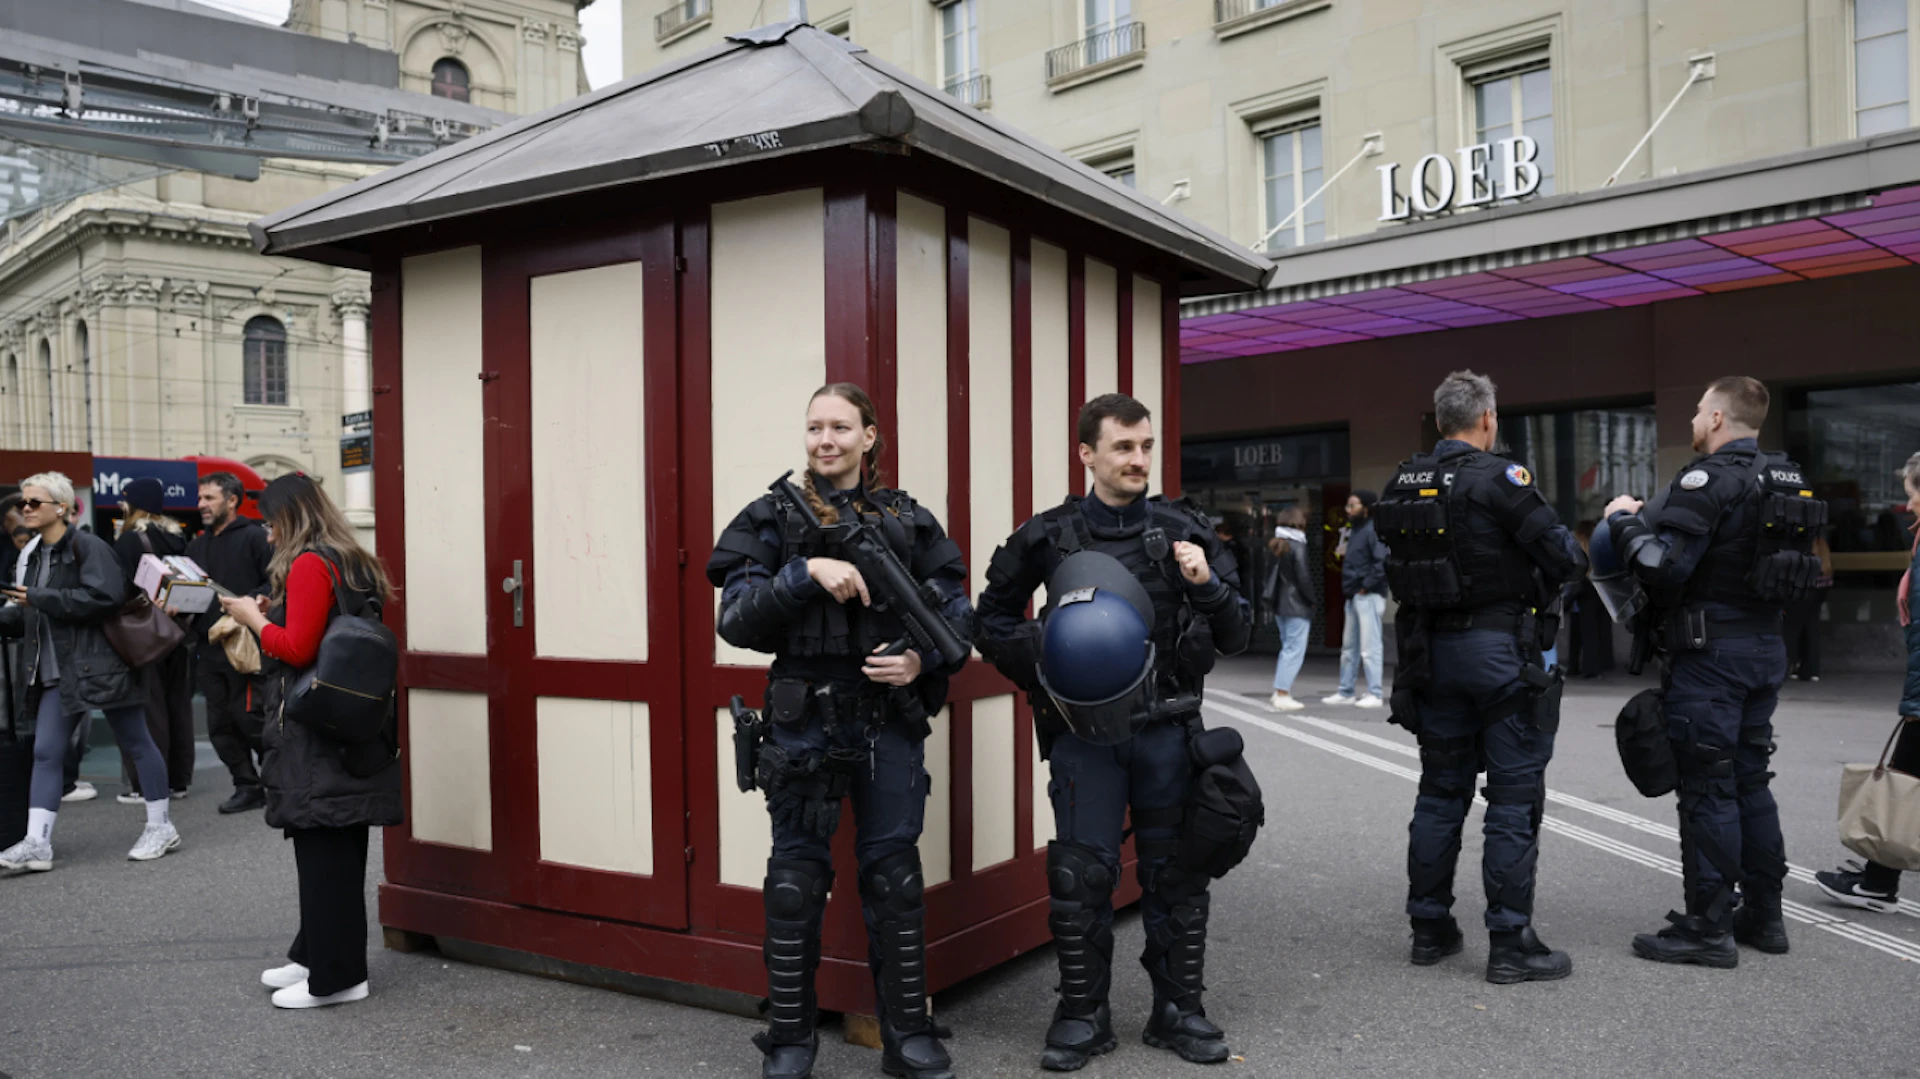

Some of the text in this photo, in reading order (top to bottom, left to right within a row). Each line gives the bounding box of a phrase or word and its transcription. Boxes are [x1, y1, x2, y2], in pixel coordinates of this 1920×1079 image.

[1376, 135, 1541, 222] LOEB
[1234, 443, 1282, 467] LOEB
[1397, 471, 1434, 485] POLICE
[1770, 469, 1804, 484] POLICE
